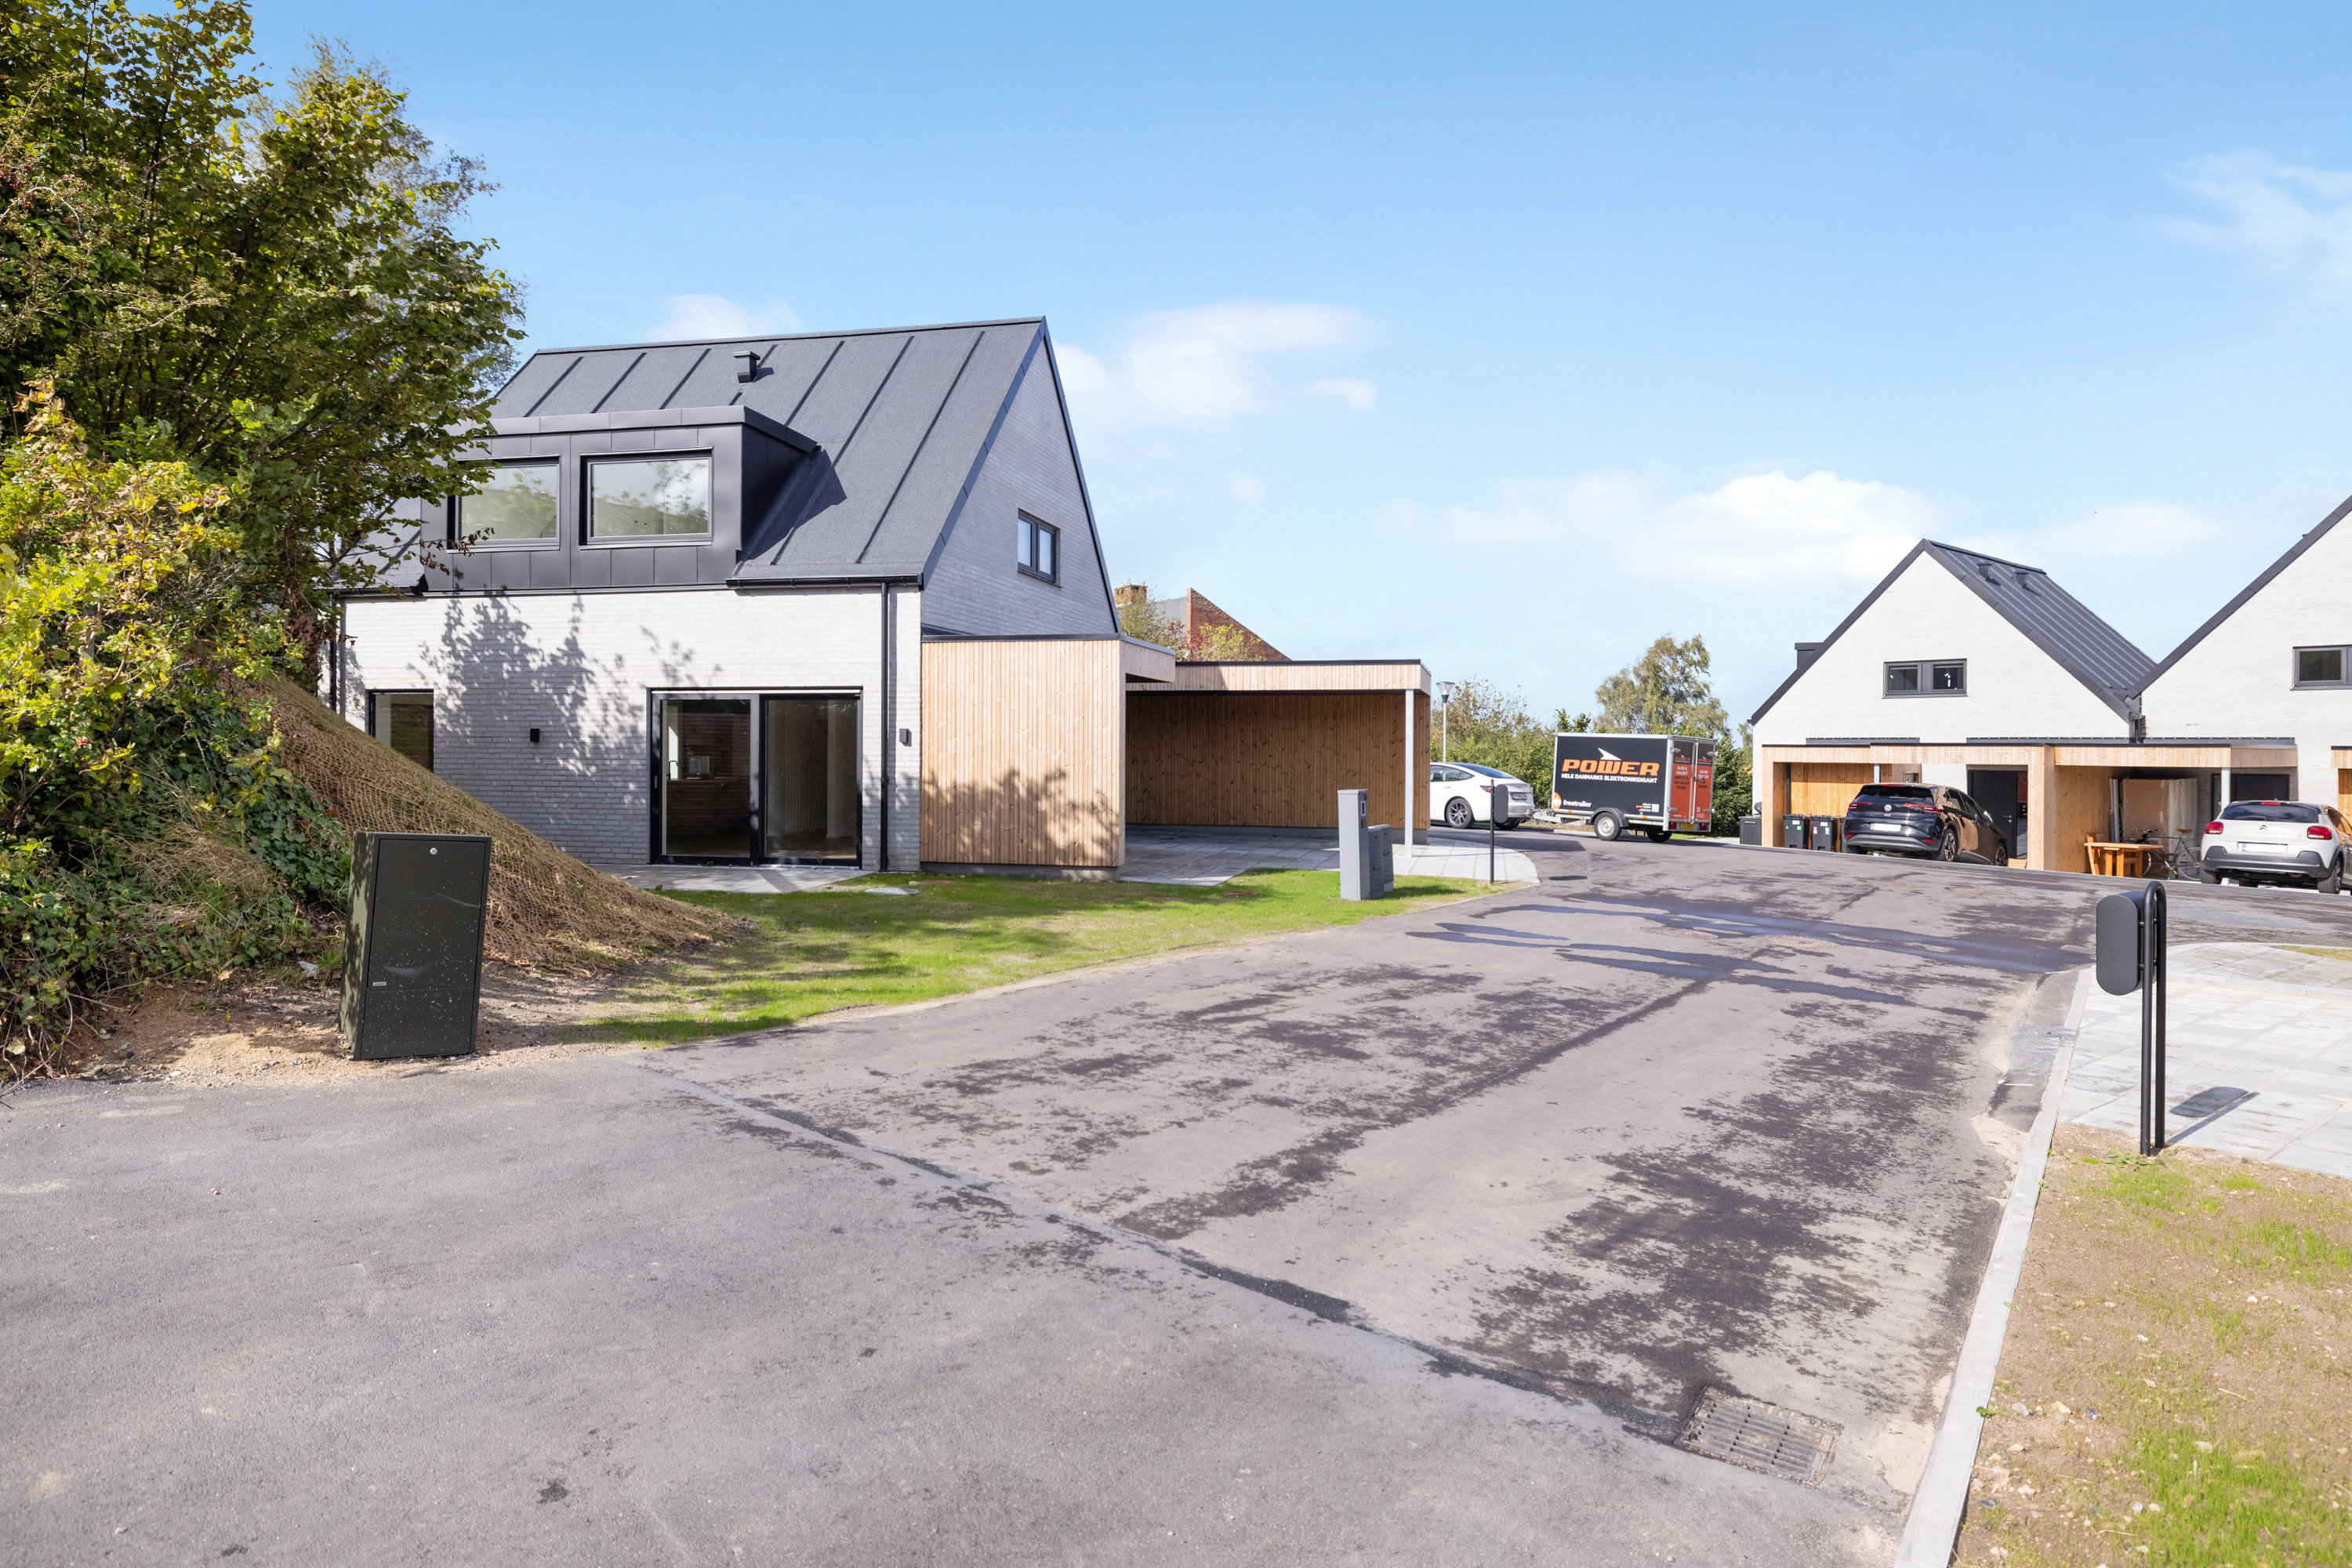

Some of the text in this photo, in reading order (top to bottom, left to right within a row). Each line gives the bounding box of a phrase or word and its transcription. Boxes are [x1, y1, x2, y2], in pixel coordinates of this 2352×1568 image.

[1562, 759, 1660, 776] POWER
[1604, 775, 1658, 783] ELEKTRONIKGIGANT
[1563, 799, 1592, 808] freetrailer
